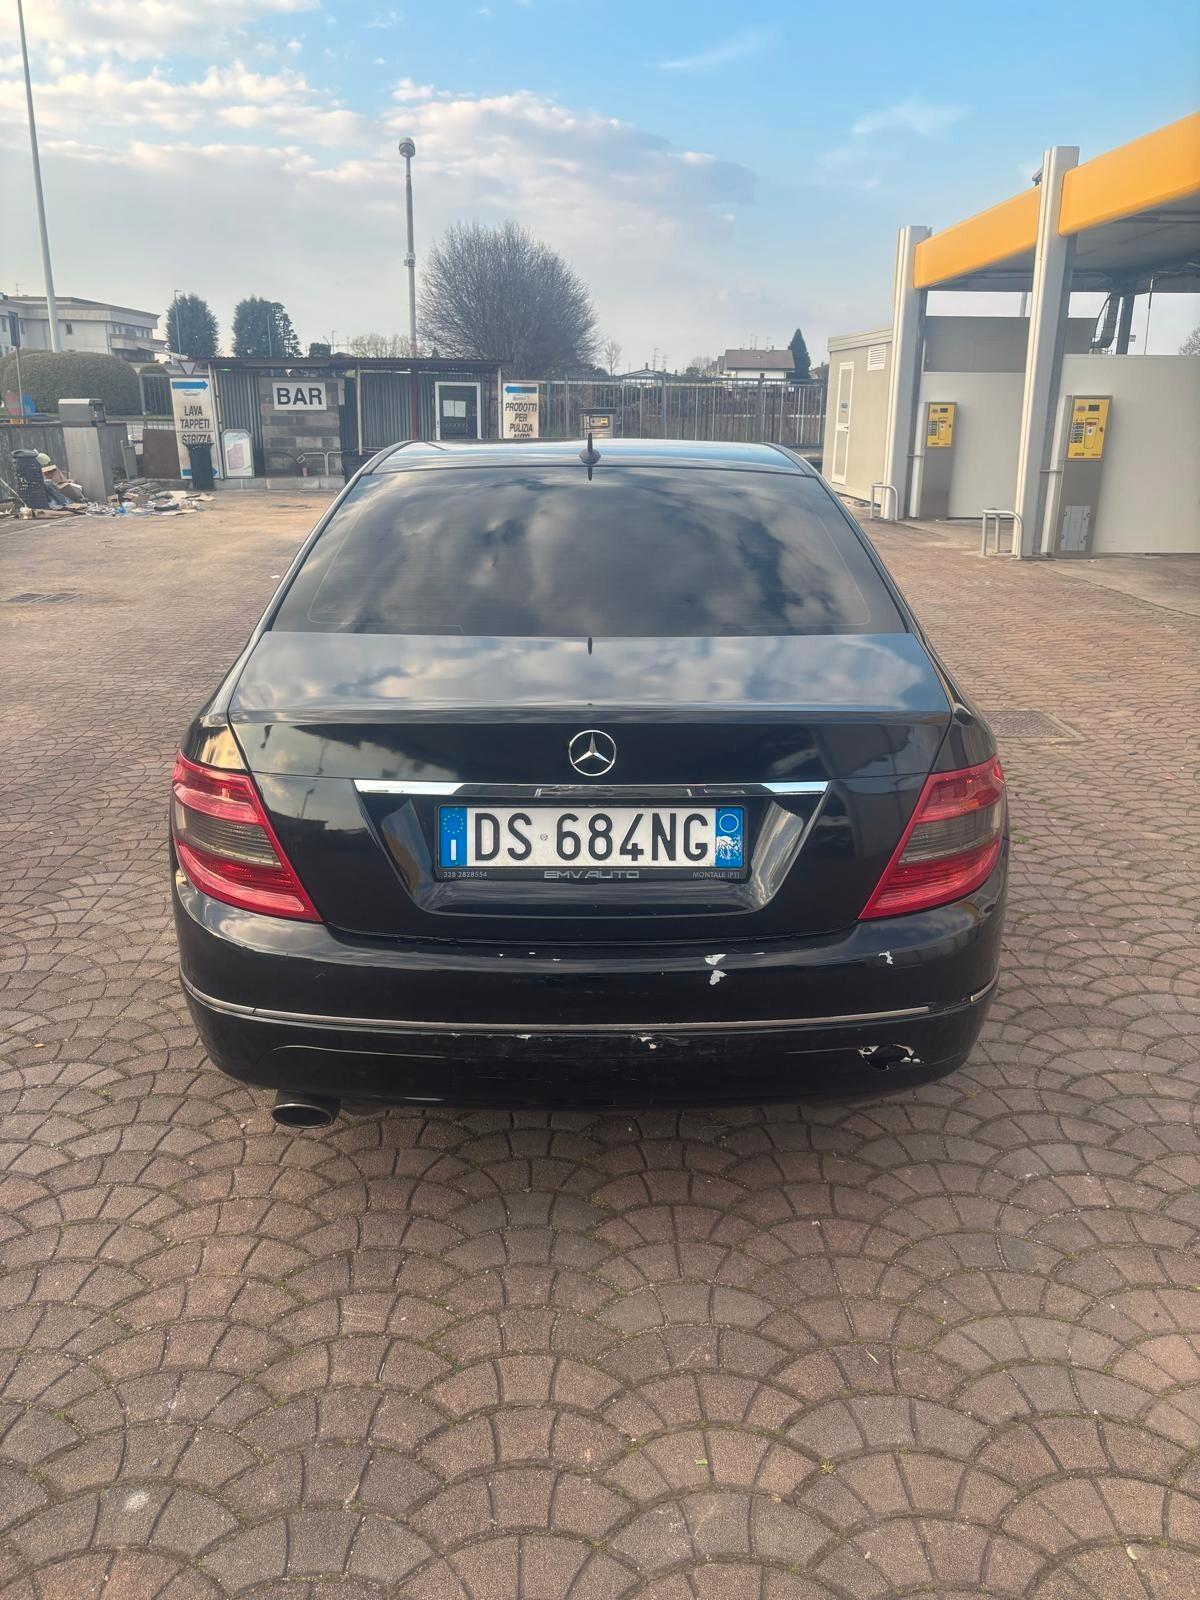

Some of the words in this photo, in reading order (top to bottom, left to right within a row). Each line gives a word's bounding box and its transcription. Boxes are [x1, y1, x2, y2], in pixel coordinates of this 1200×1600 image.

[277, 387, 322, 405] BAR
[184, 405, 203, 417] LAVA
[505, 402, 537, 412] PRODOTTI
[514, 413, 528, 422] PER
[180, 419, 210, 429] TAPPETI
[509, 423, 533, 433] PULIZIA
[474, 812, 533, 861] DS
[555, 812, 709, 862] 684NG
[457, 871, 487, 879] 2828554
[543, 870, 639, 879] EMVAUTO
[692, 871, 726, 879] MONTALE
